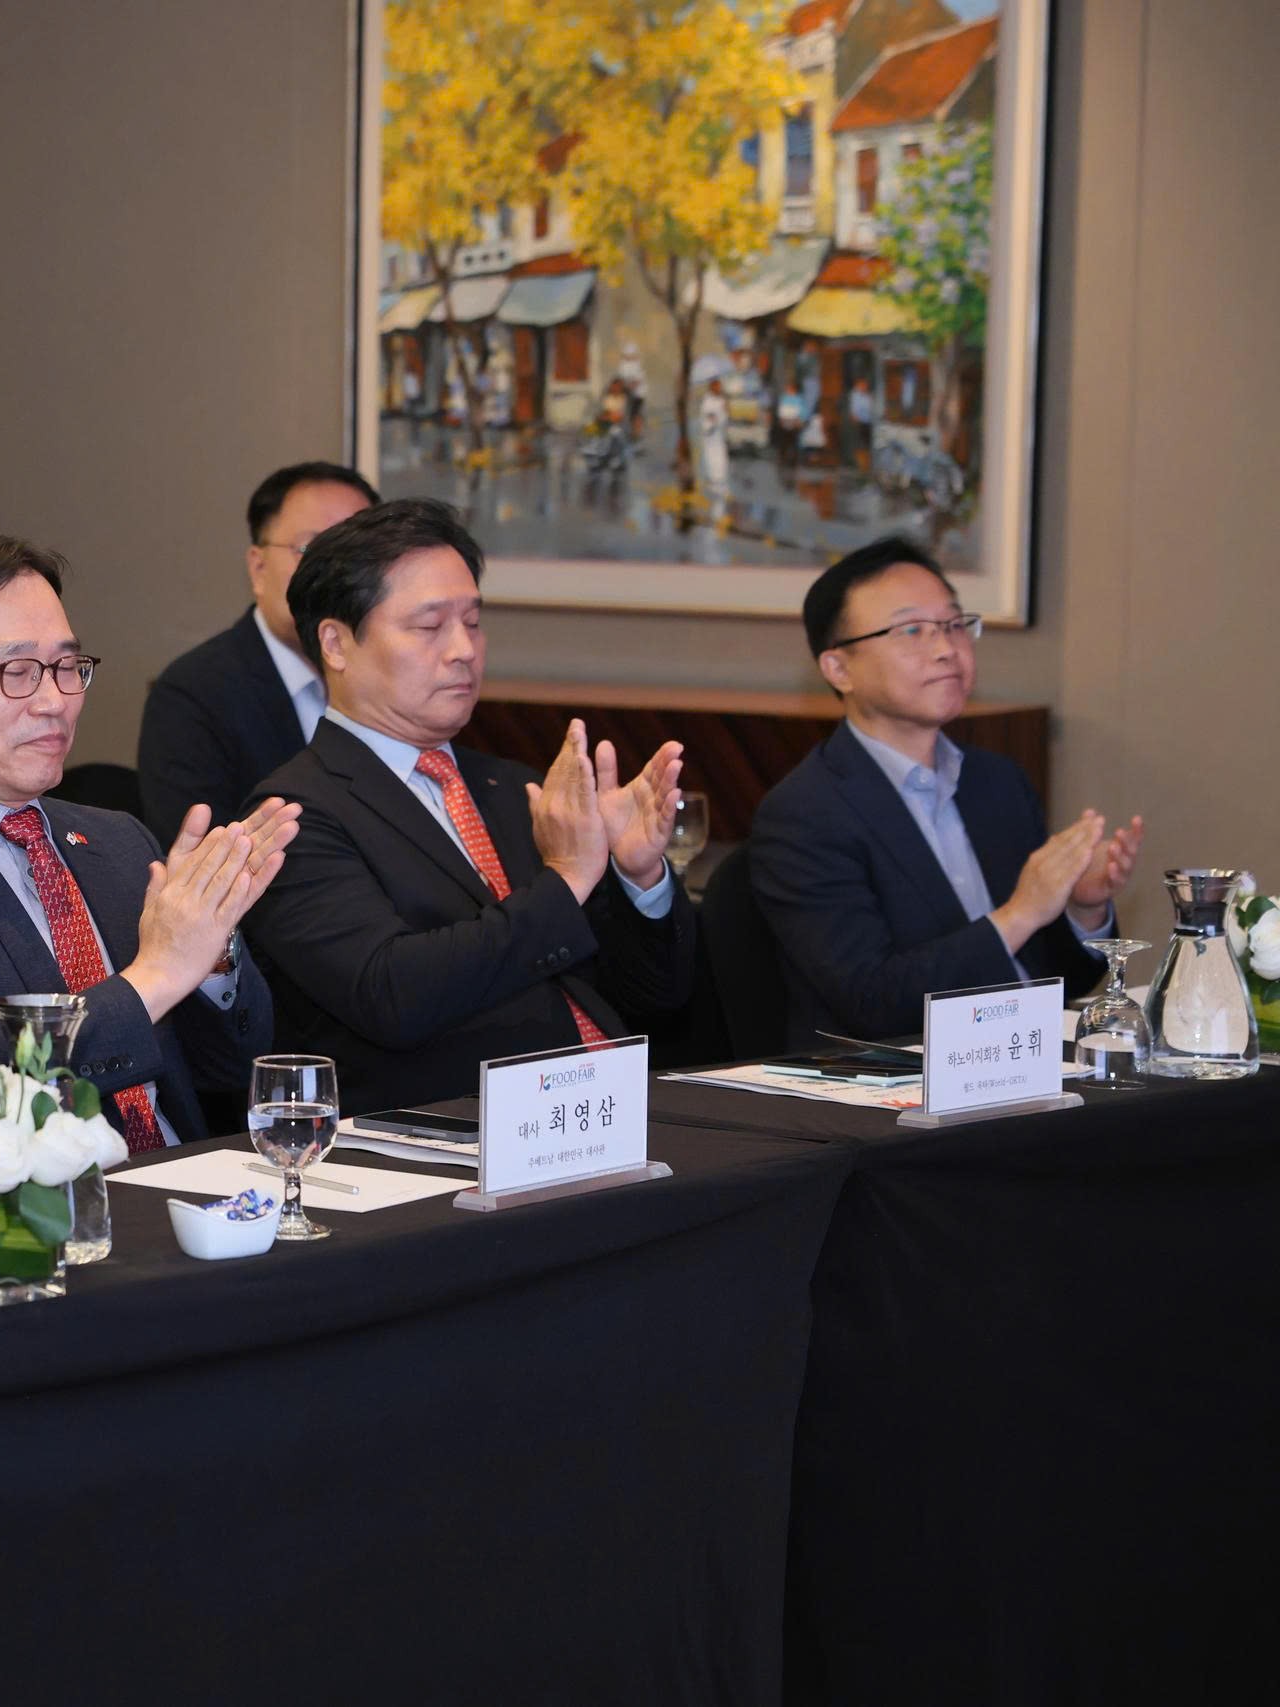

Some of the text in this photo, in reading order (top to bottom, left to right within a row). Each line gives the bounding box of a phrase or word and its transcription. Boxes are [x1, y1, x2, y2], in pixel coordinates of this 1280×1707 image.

[983, 1005, 1004, 1018] FOOD
[1004, 1003, 1019, 1016] FAIR
[551, 1070, 577, 1085] FOOD
[578, 1067, 596, 1081] FAIR
[518, 1119, 541, 1141] 대사
[528, 1144, 605, 1169] 주베트남 대한민국 대사관
